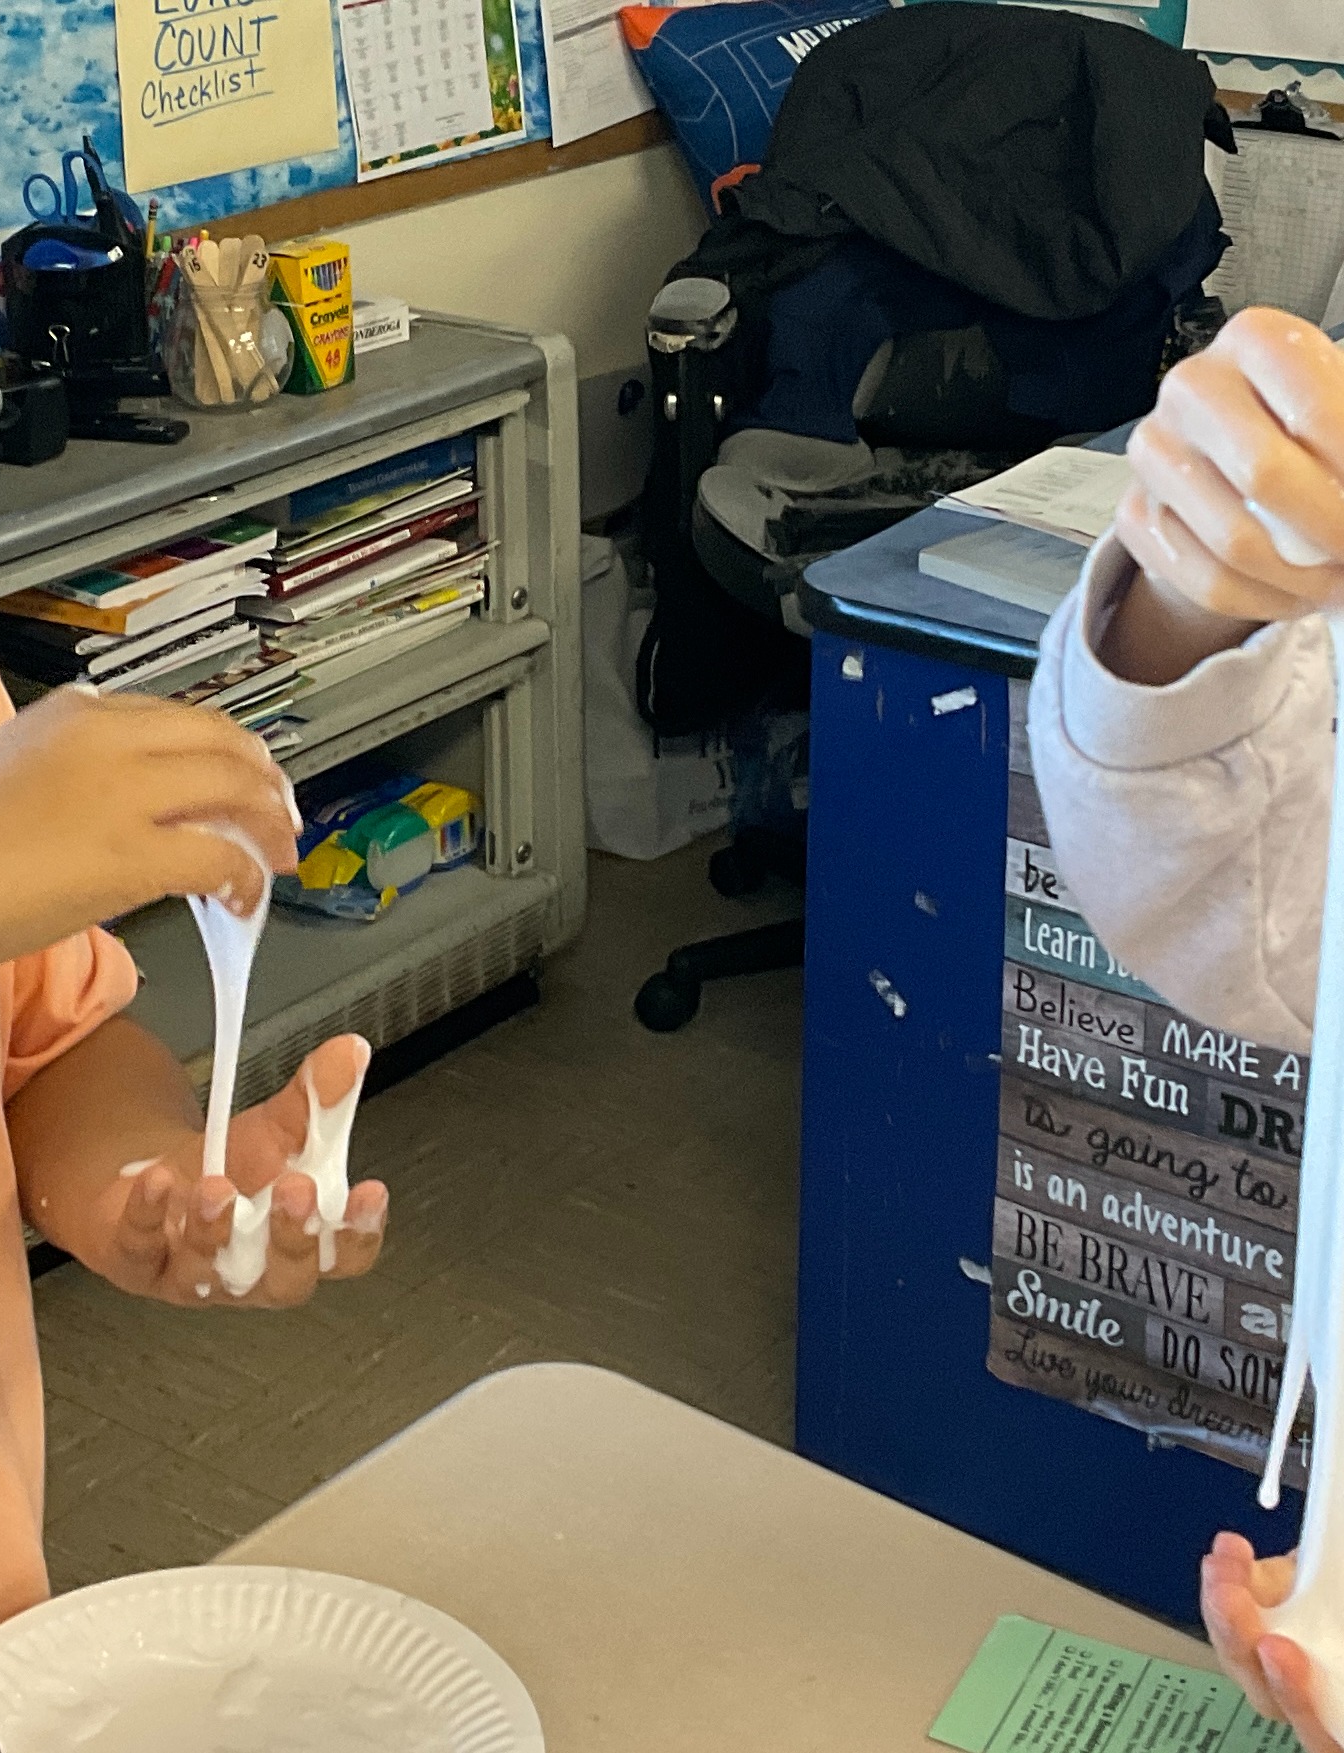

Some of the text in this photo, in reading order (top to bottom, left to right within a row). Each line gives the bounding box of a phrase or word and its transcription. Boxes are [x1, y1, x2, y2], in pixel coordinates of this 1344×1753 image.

[154, 15, 278, 71] COUNT
[141, 59, 266, 119] Checklist
[310, 303, 350, 326] Crayola
[354, 319, 402, 341] ONDEROGA
[1024, 848, 1059, 900] be
[1024, 907, 1096, 969] Learn
[1012, 968, 1135, 1044] Believe
[1016, 1024, 1189, 1116] Have Fun
[1162, 1019, 1260, 1079] MAKE
[1273, 1053, 1301, 1091] A
[1086, 1127, 1219, 1201] going
[1232, 1157, 1288, 1209] to
[1013, 1149, 1284, 1279] is an adventure
[1014, 1208, 1065, 1273] BE
[1079, 1232, 1211, 1325] BRAVE
[1006, 1268, 1125, 1348] Smile
[1162, 1325, 1201, 1380] DO
[1167, 1383, 1269, 1442] dream
